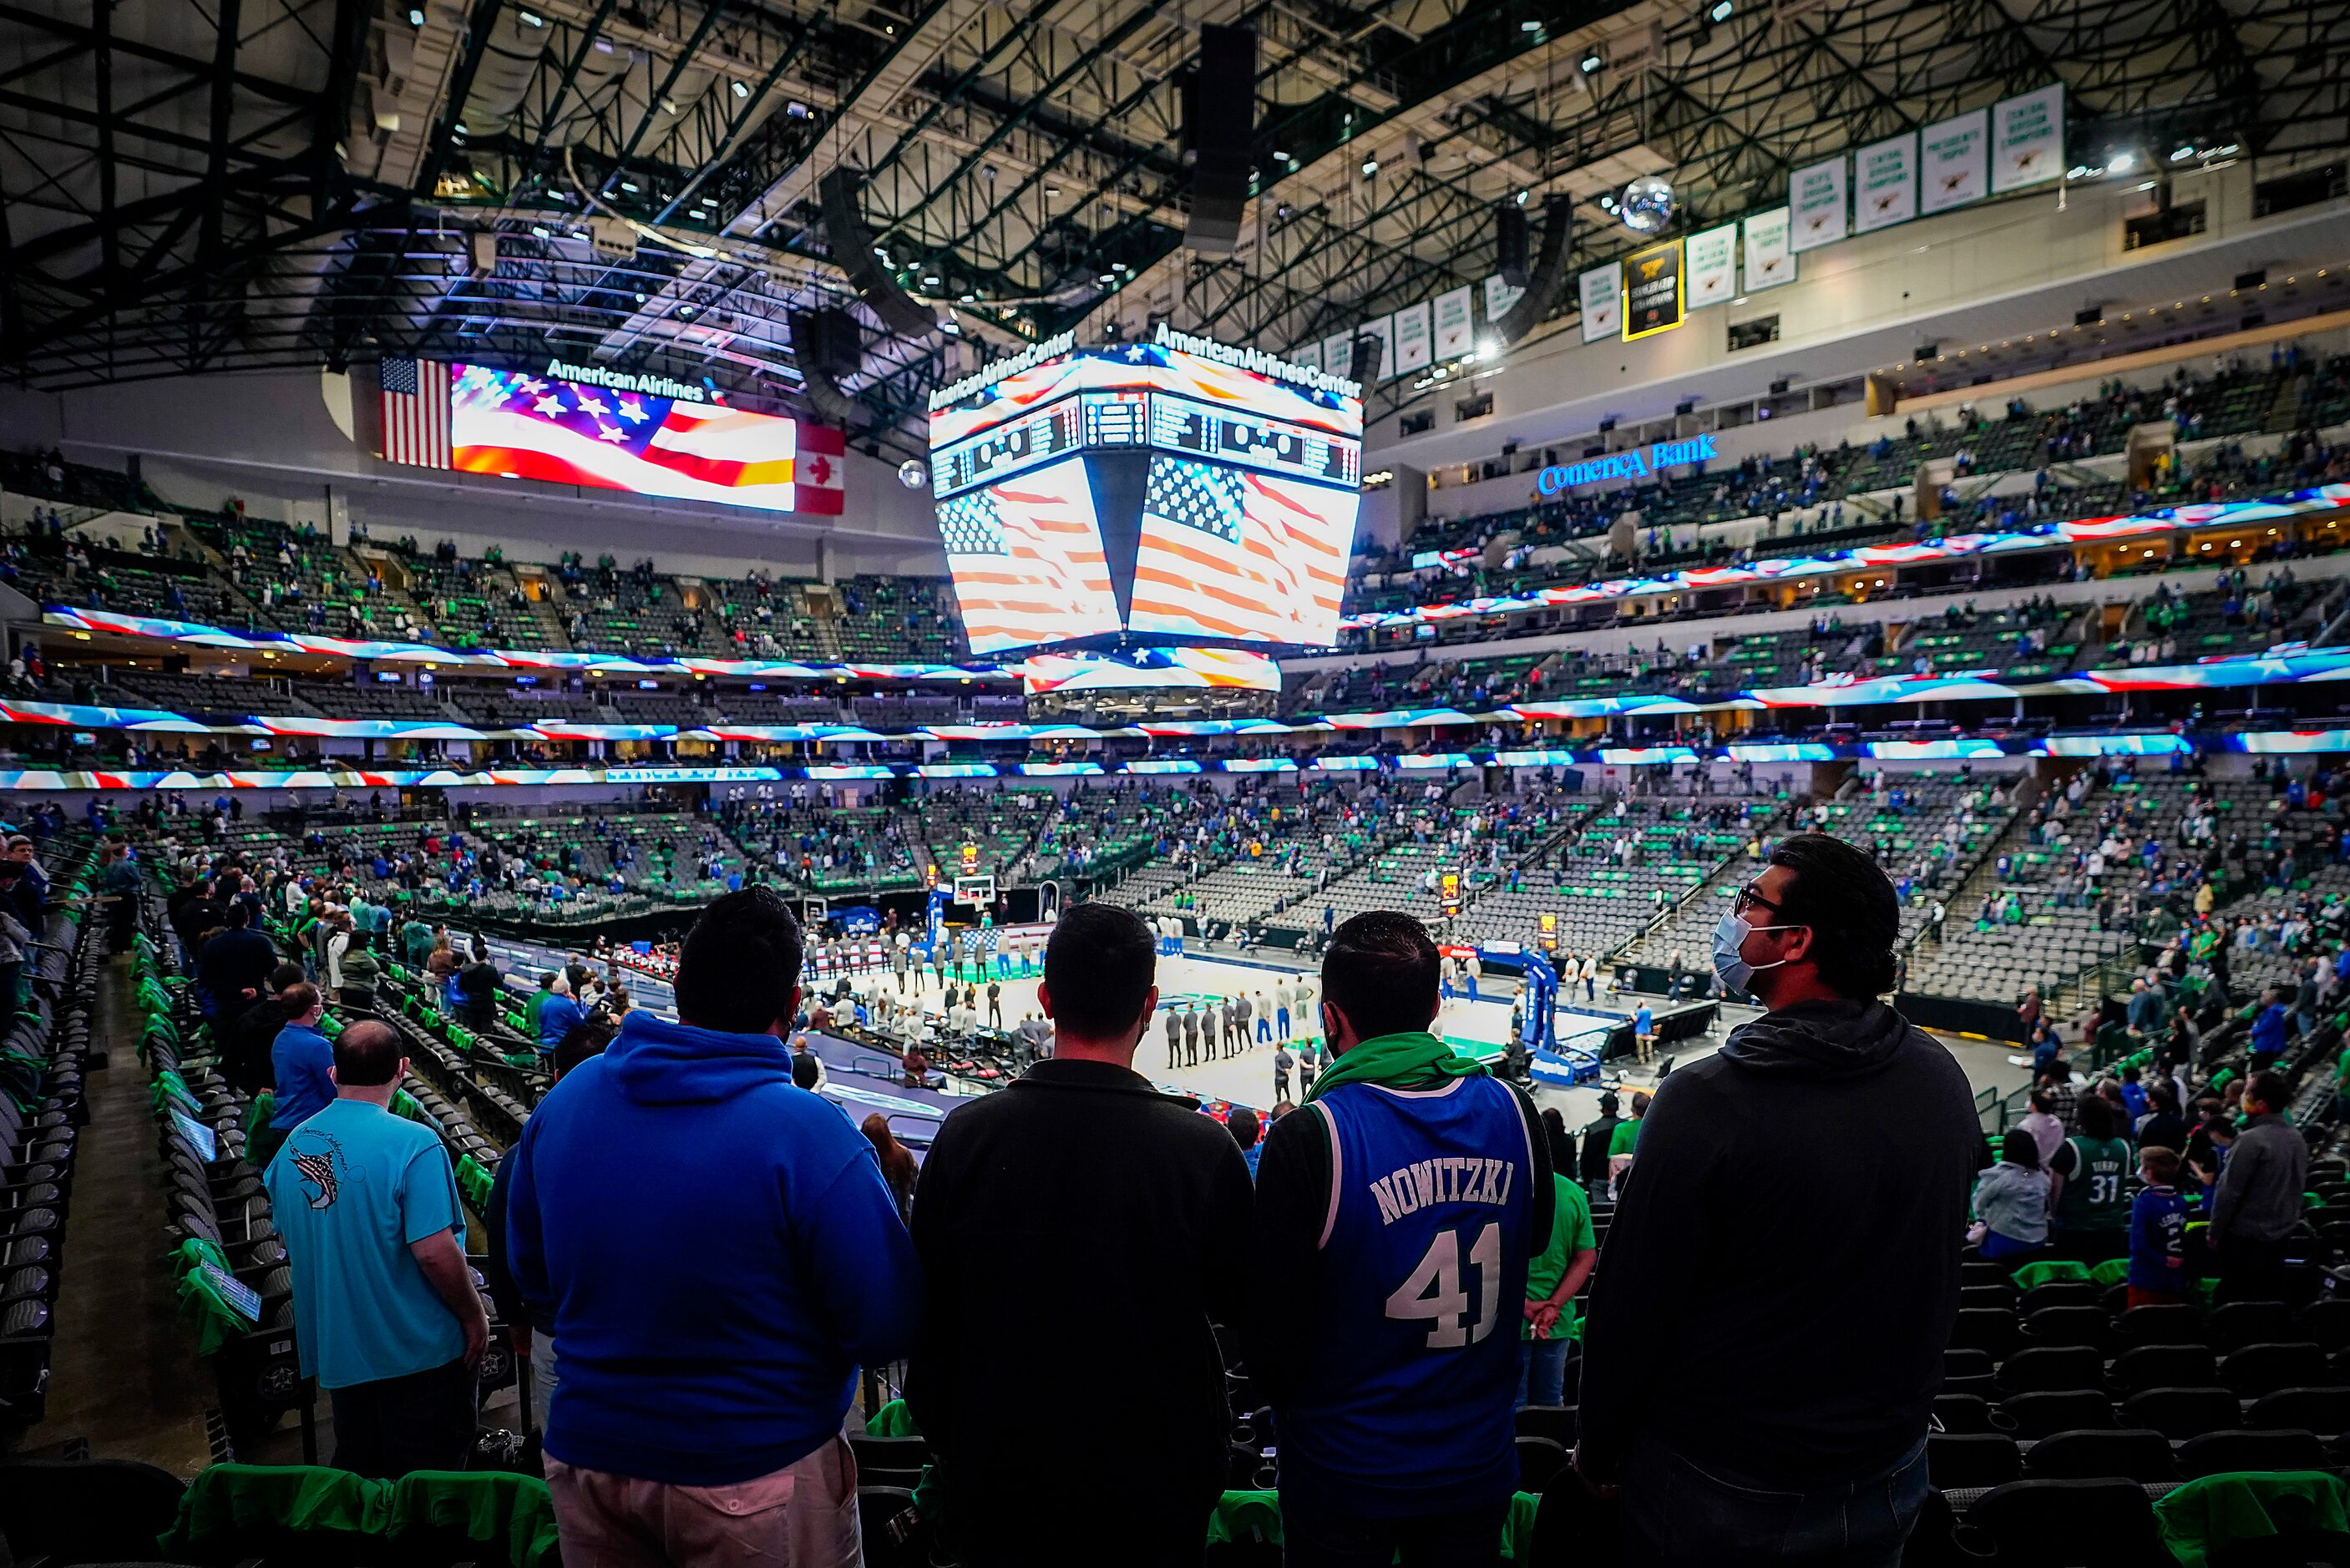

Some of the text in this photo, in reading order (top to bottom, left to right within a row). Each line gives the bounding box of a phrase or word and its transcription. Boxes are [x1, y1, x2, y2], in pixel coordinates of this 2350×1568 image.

[1650, 432, 1718, 471] Bank
[1369, 1156, 1514, 1226] NOWITZKI
[2089, 1175, 2120, 1203] 31
[1385, 1222, 1501, 1348] 41
